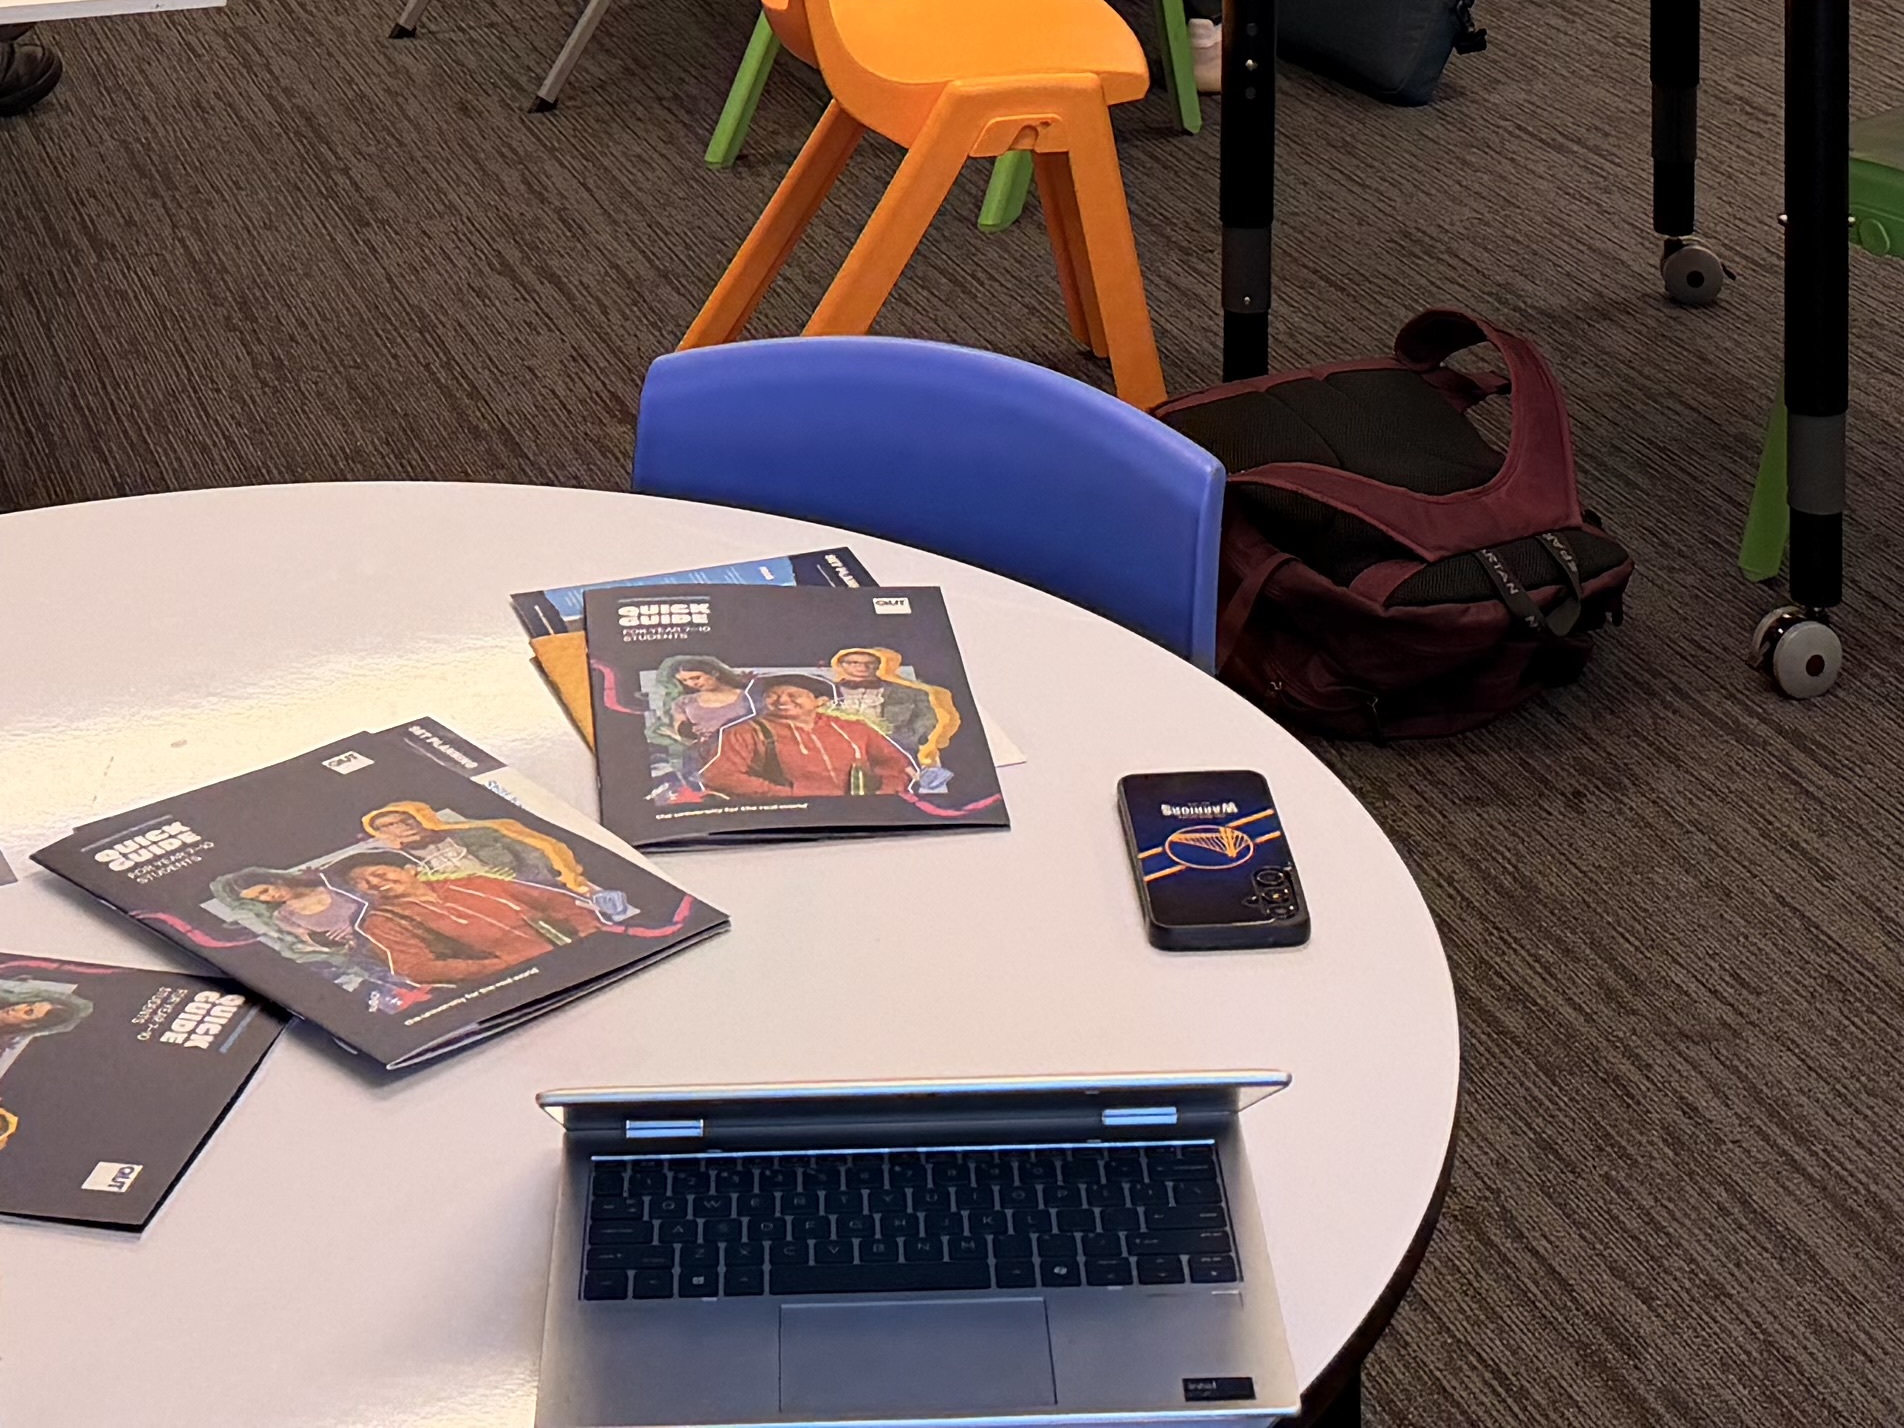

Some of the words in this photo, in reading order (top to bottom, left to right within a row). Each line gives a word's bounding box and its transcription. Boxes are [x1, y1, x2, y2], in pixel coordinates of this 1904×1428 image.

[618, 603, 711, 617] QUICK
[618, 614, 709, 626] GUIDE
[95, 821, 191, 862] QUICK
[108, 831, 202, 872] GUIDE
[136, 855, 202, 884] STUDENTS
[159, 990, 221, 1044] GUIDE
[183, 994, 245, 1050] QUICK
